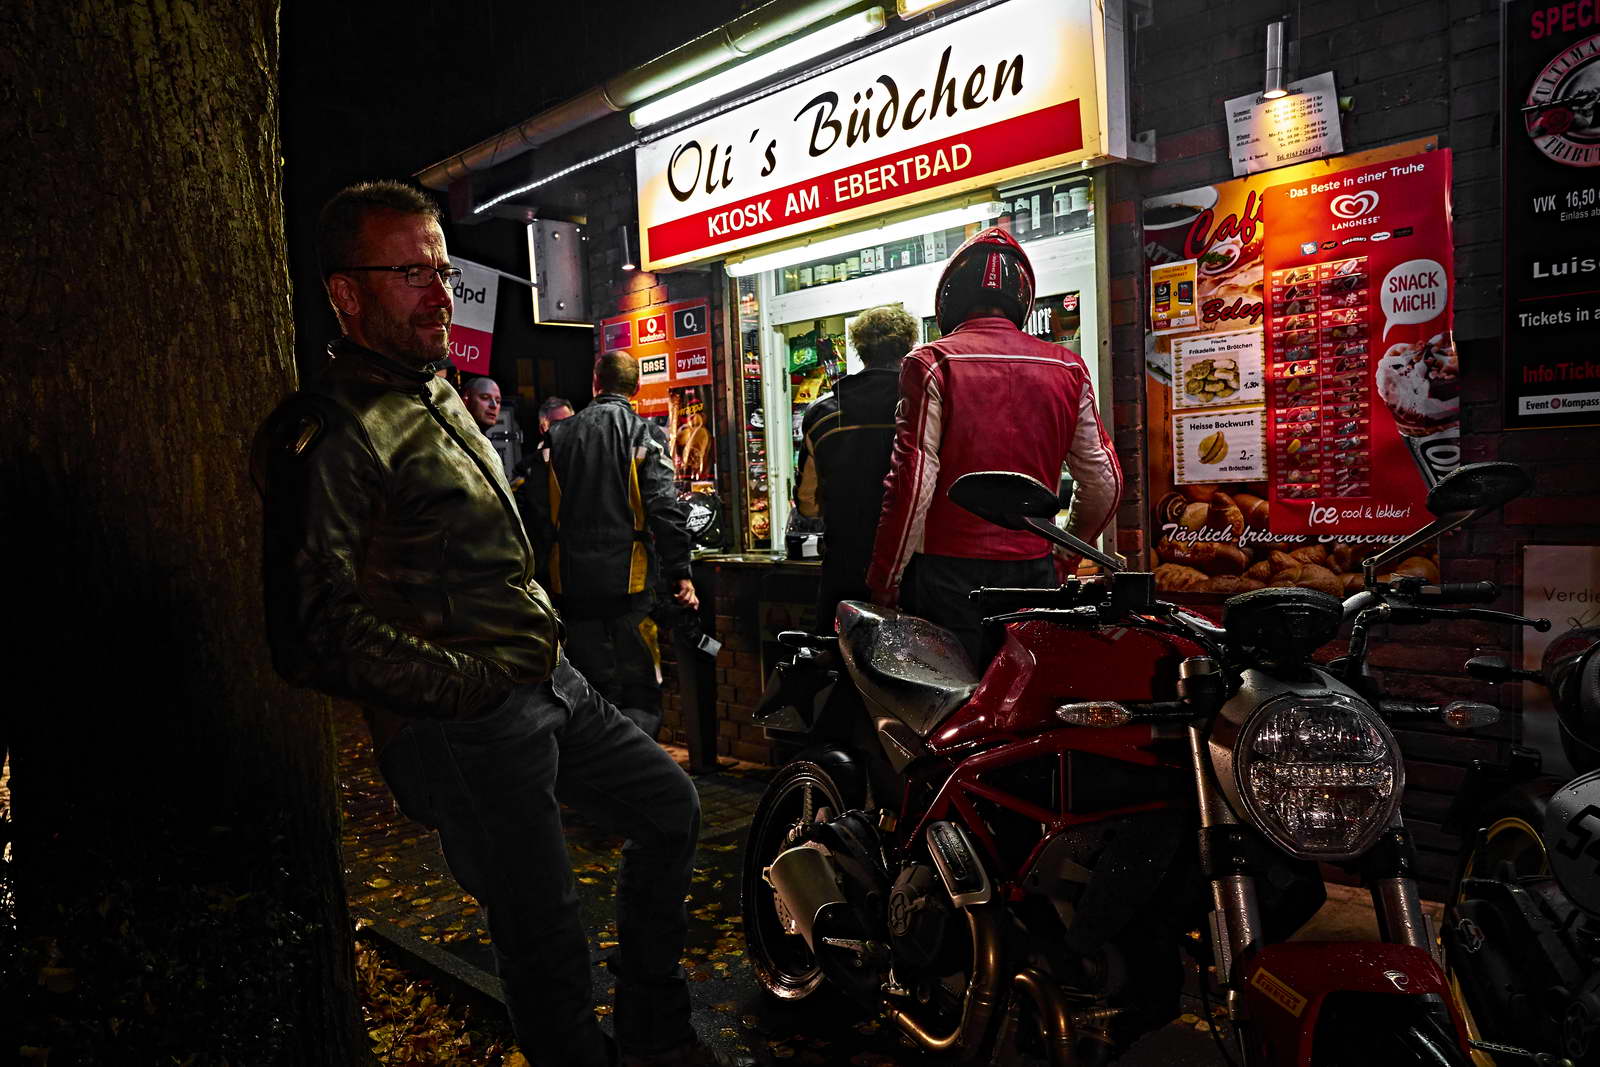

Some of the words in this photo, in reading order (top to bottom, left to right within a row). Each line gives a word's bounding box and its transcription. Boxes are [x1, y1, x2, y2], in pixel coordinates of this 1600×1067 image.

[794, 45, 1025, 158] Büdchen
[707, 199, 773, 238] KIOSK
[784, 186, 820, 217] AM
[834, 143, 972, 203] EBERTBAD
[1290, 187, 1308, 198] Das
[1311, 180, 1341, 194] Beste
[1343, 177, 1354, 187] in
[1357, 170, 1388, 185] einer
[1390, 162, 1425, 177] Truhe
[1533, 194, 1556, 214] VVK
[1566, 187, 1595, 209] 16,50
[1331, 216, 1378, 231] LANGNESE
[1560, 210, 1589, 222] Einlass
[1533, 256, 1600, 279] Luis
[453, 281, 486, 304] dpd
[1388, 270, 1440, 295] SNACK
[1518, 310, 1572, 328] Tickets
[1576, 307, 1589, 322] in
[642, 359, 665, 373] BASE
[1525, 400, 1549, 411] Event
[1561, 397, 1600, 409] Kompass
[1189, 422, 1213, 431] Heisse
[1214, 419, 1254, 430] Bockwurst
[1309, 500, 1339, 526] Ice,
[1341, 508, 1362, 519] cool
[1364, 507, 1372, 519] &
[1375, 504, 1411, 519] lekker!
[1162, 522, 1233, 548] Täglich
